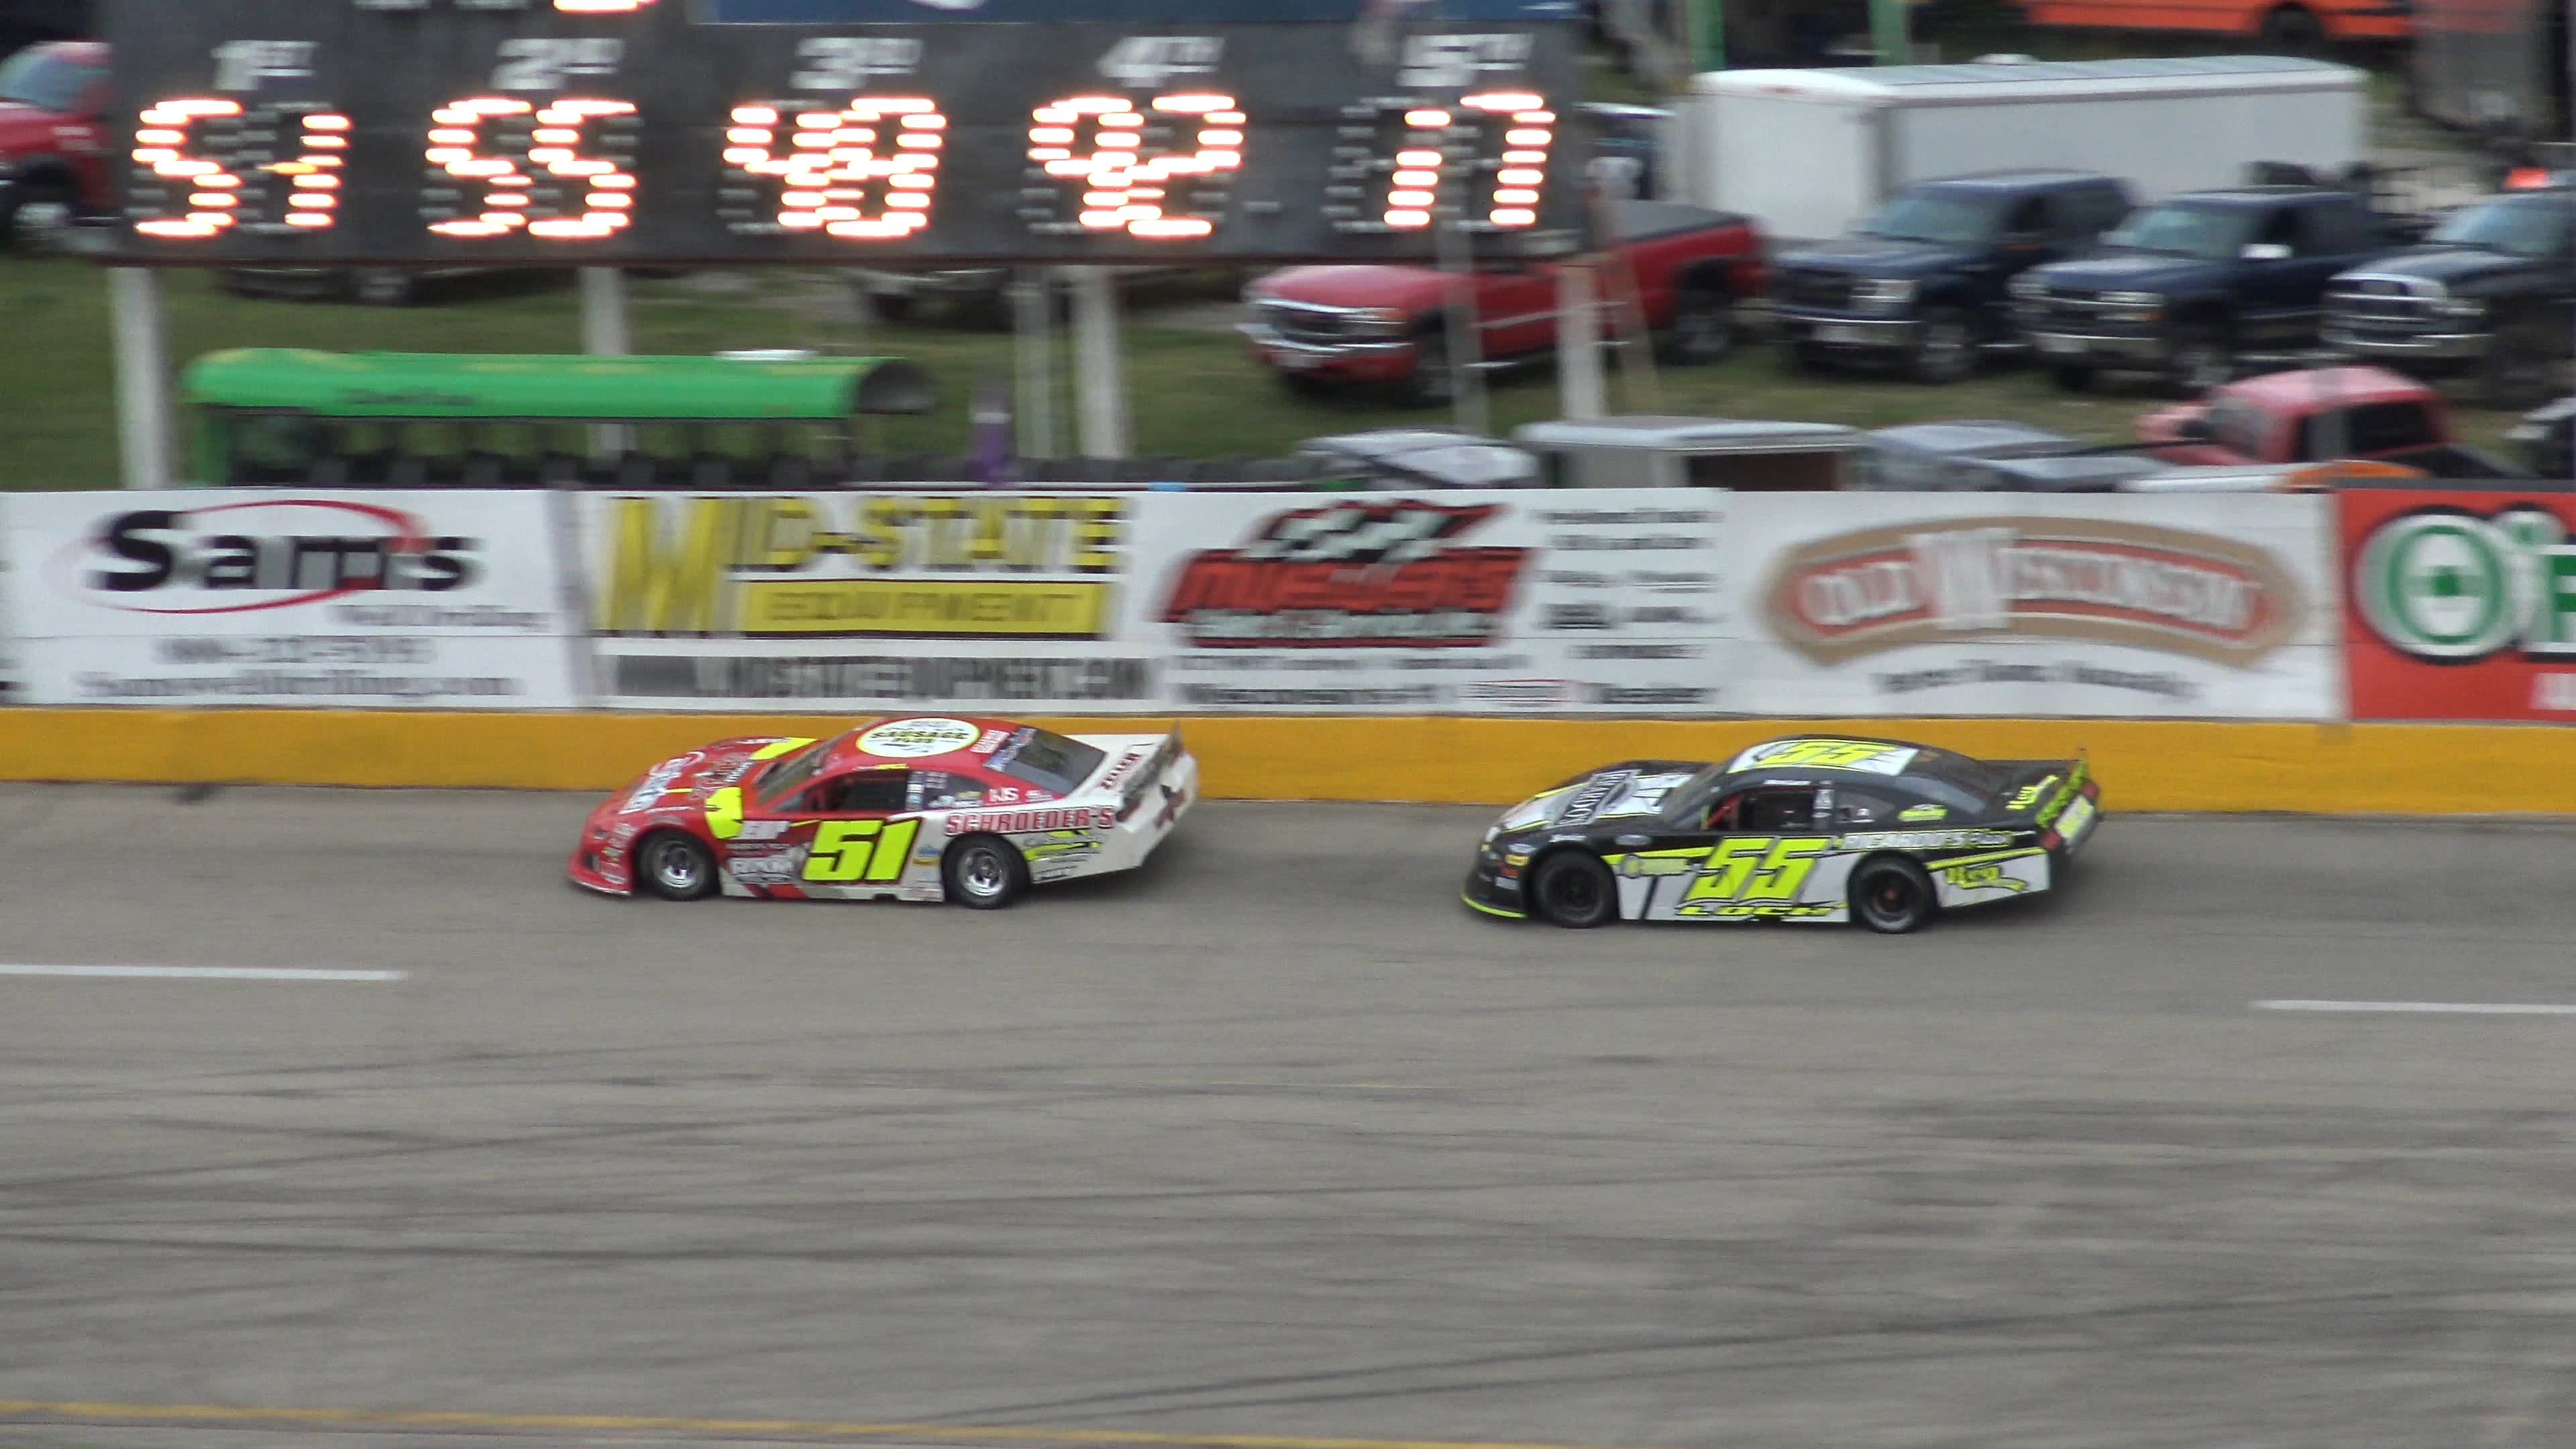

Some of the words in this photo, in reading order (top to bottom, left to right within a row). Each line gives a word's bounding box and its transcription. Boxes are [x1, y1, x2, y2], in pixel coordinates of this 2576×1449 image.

[423, 97, 639, 238] 55
[722, 95, 947, 238] 48
[1026, 94, 1246, 238] 92
[802, 820, 922, 881] 51
[945, 806, 1115, 837] SCHROEDER'S
[1684, 836, 1835, 900] 55
